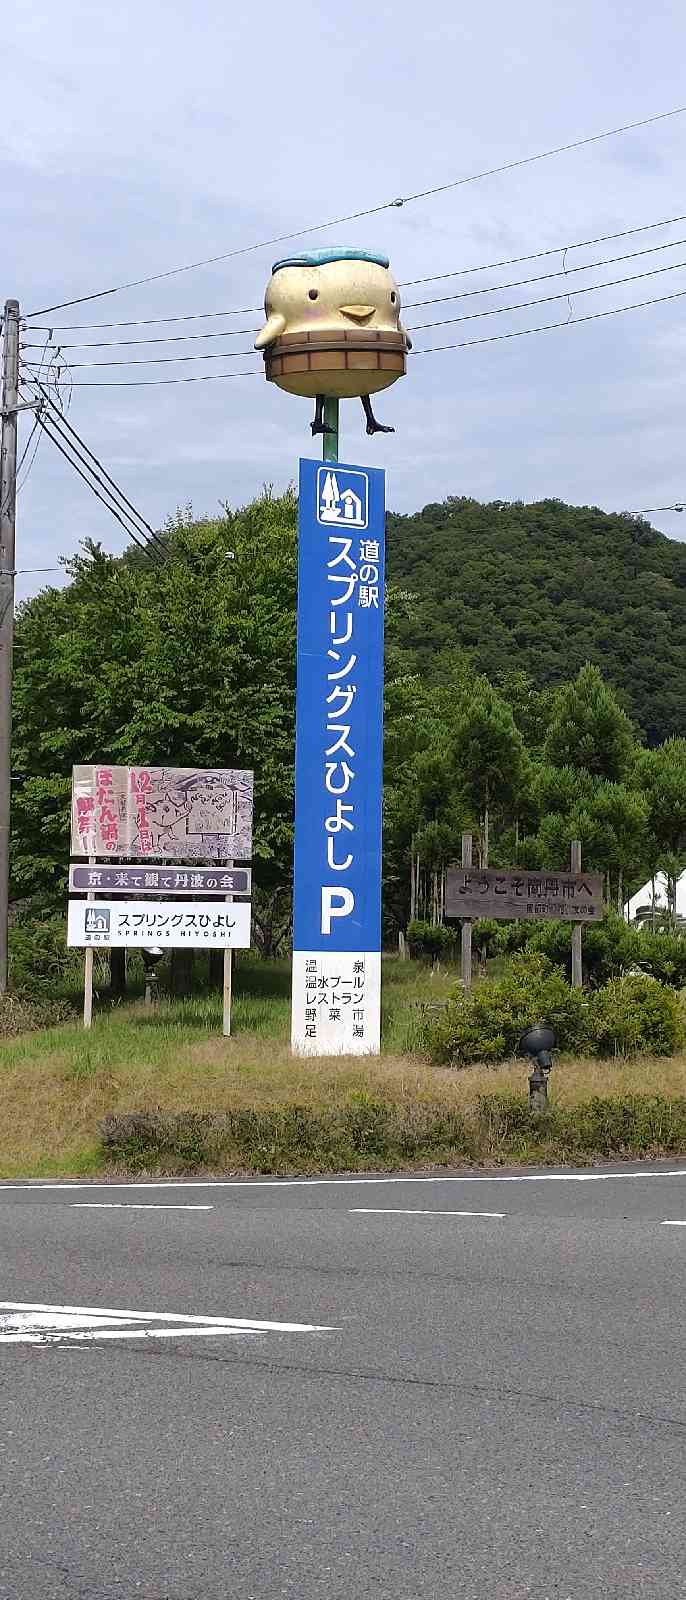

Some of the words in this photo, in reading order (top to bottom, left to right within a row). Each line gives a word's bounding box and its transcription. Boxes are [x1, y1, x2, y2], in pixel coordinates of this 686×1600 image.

[358, 539, 380, 609] 道の駅
[325, 536, 359, 871] スプリングスひよし
[87, 871, 234, 889] 京・来て観て丹波の会
[320, 886, 355, 936] P
[118, 913, 237, 928] スプリングスひよし
[180, 930, 232, 938] HIYOSHI
[305, 975, 365, 989] 温水プール
[306, 991, 365, 1005] レストラン
